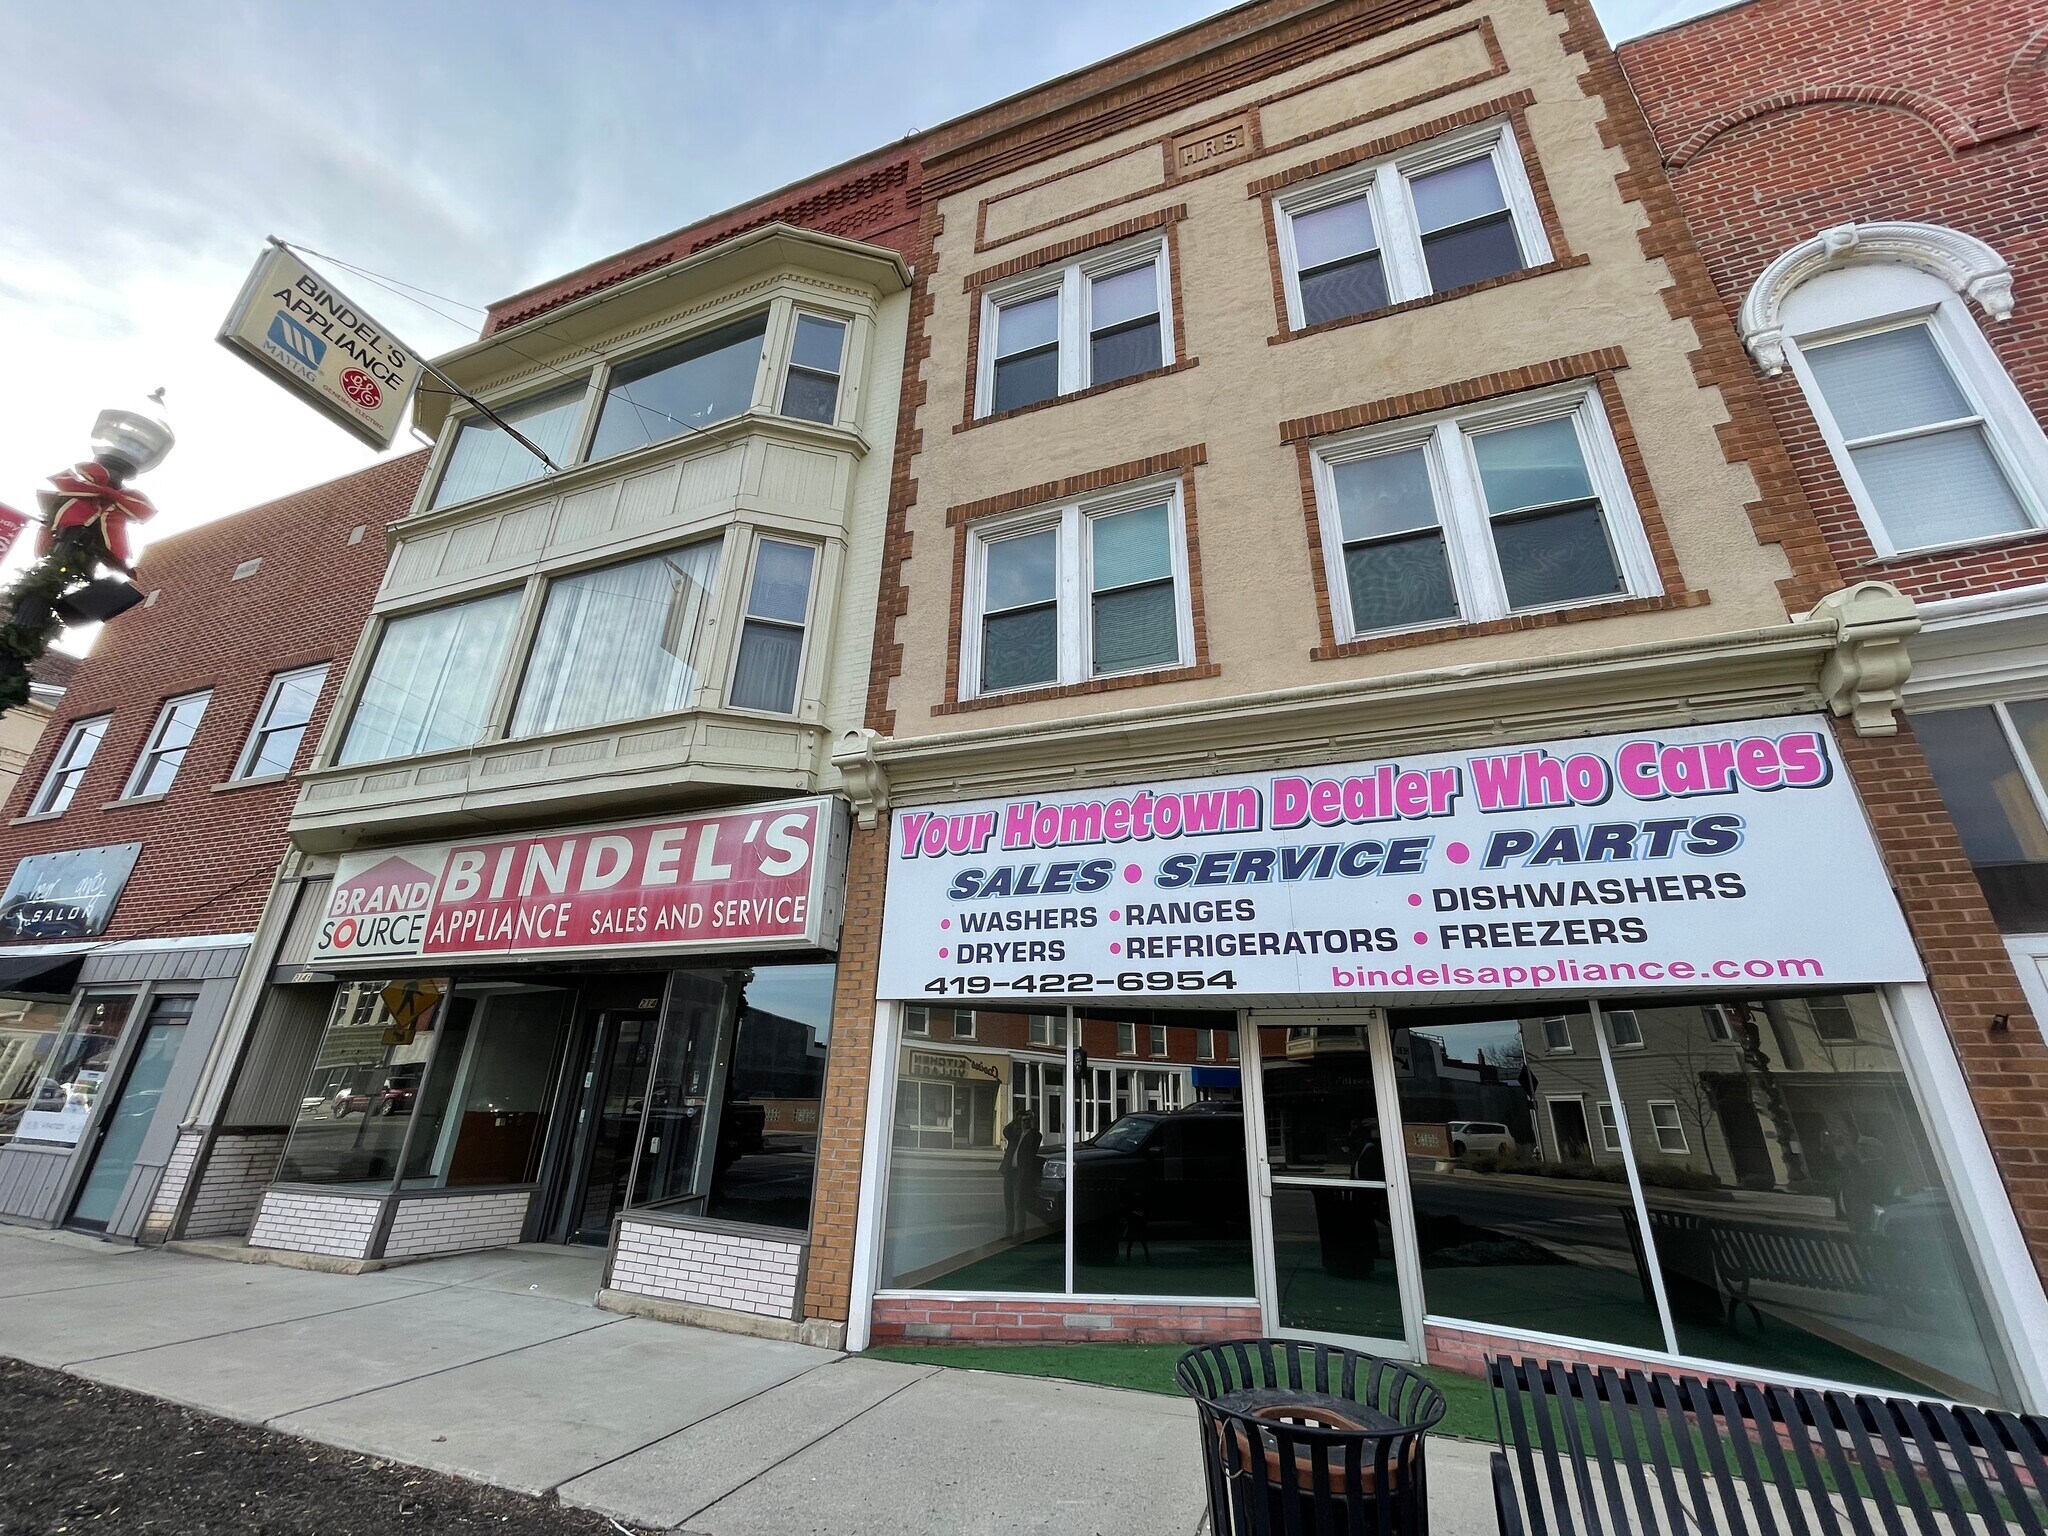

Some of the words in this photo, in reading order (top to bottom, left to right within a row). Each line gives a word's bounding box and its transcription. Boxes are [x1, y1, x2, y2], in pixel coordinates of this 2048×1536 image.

[273, 288, 404, 390] APPLIANCE
[295, 275, 406, 368] BINDEL'S
[262, 339, 317, 383] MAYTAG
[322, 383, 352, 410] GENERAL
[354, 407, 384, 432] ELECTRIC
[900, 811, 998, 859] Your
[1000, 785, 1262, 852] Hometown
[1270, 763, 1463, 831] Dealer
[1468, 748, 1614, 814] Who
[1615, 732, 1832, 802] Cares
[440, 813, 810, 903] BINDEL'S
[947, 857, 1117, 900] SALES
[1154, 836, 1435, 889] SERVICE
[1480, 812, 1746, 870] PARTS
[331, 882, 431, 916] BRAND
[1433, 872, 1746, 912] DISHWASHERS
[32, 905, 95, 923] SALON
[429, 902, 572, 944] APPLIANCE
[590, 905, 648, 934] SALES
[654, 902, 703, 930] AND
[712, 896, 805, 926] SERVICE
[960, 905, 1098, 933] WASHERS
[1126, 898, 1256, 926] RANGES
[318, 913, 426, 950] SOURCE
[1126, 926, 1399, 960] REFRIGERATORS
[1439, 917, 1648, 949] FREEZERS
[957, 939, 1066, 965] DRYERS
[925, 970, 1237, 996] 419-422-6954
[1332, 957, 1824, 988] bindelsappliance.com
[639, 999, 657, 1008] 214
